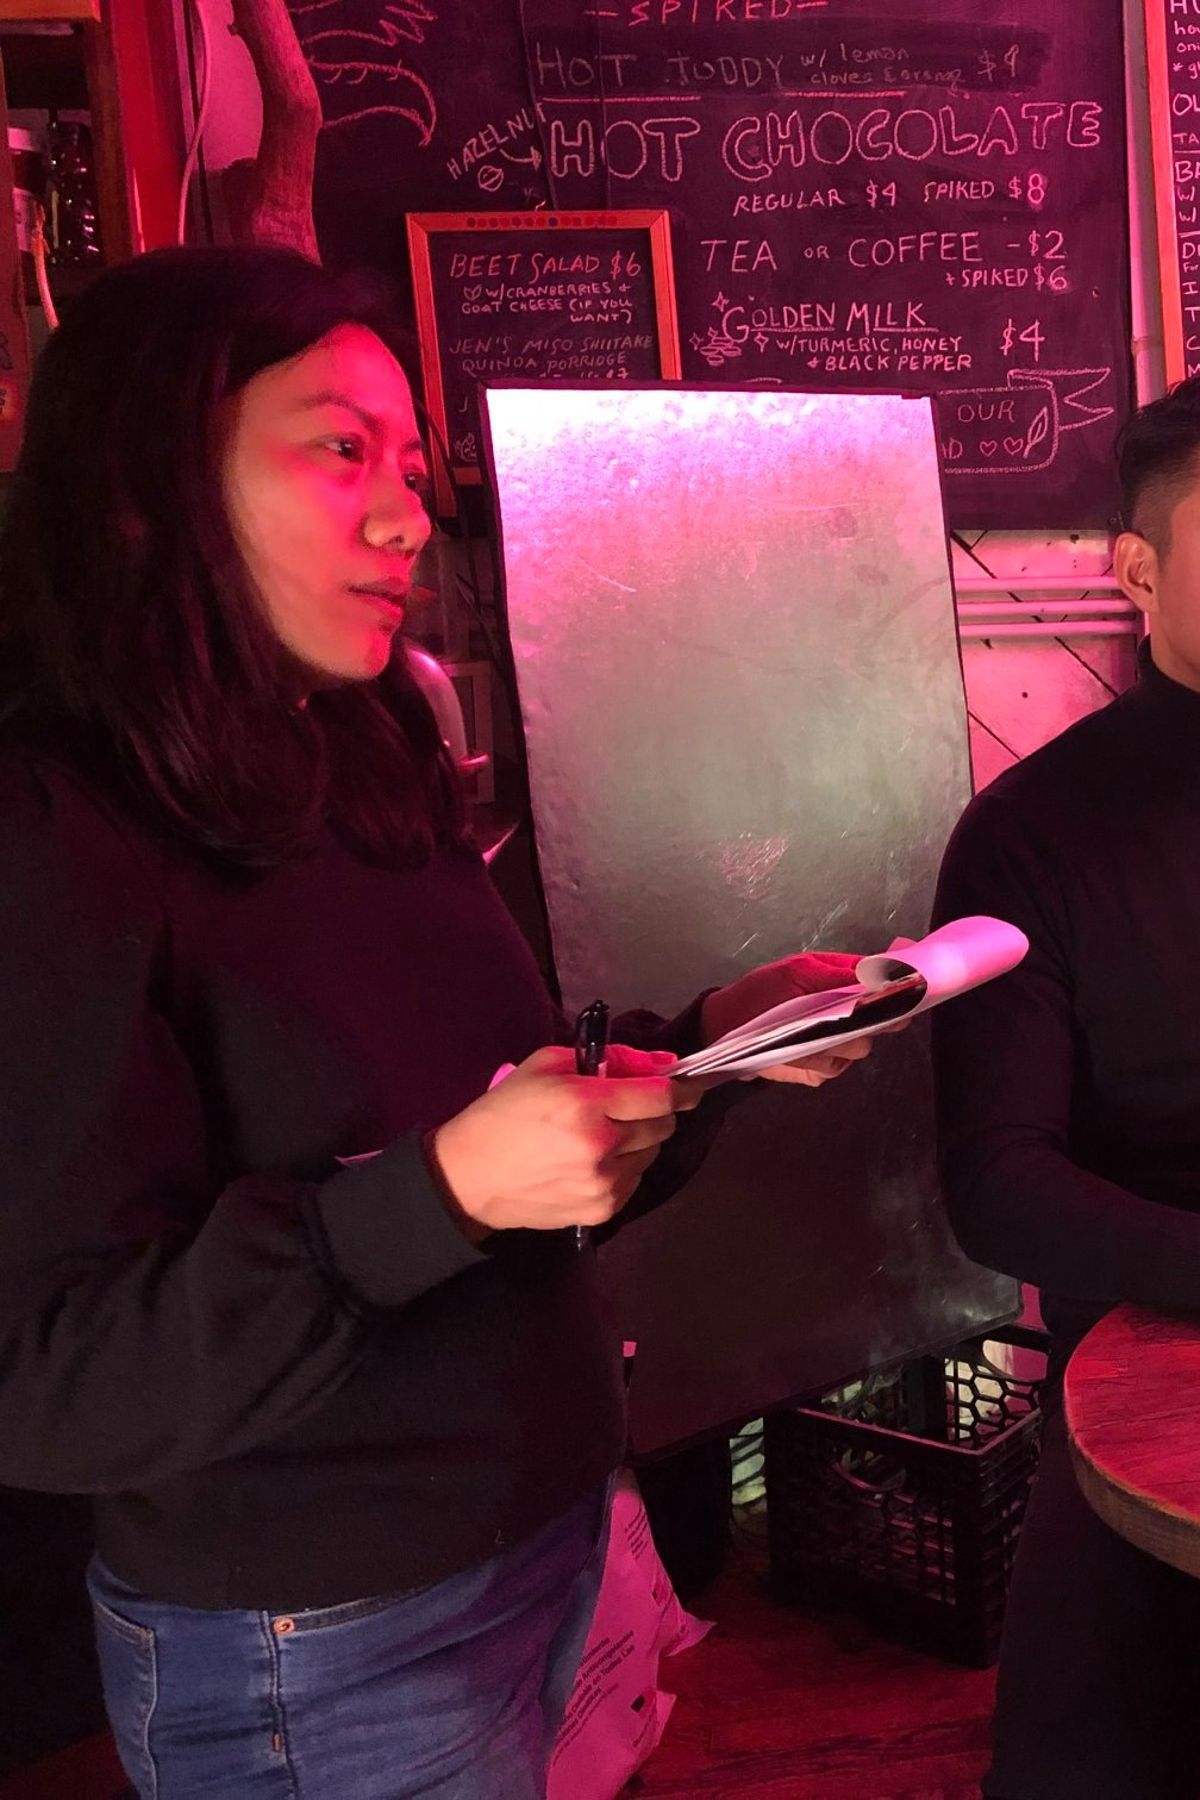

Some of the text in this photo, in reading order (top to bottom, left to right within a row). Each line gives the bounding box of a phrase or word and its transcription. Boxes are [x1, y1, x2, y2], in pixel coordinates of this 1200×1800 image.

[628, 0, 792, 27] SPIKED
[535, 41, 638, 89] HOT
[446, 102, 547, 181] HAZELNUT
[550, 100, 1103, 183] HOT CHOCOLATE
[732, 172, 1047, 216] REGULAR $4 SPIKED $8
[700, 239, 779, 273] TEA
[803, 245, 830, 260] OR
[847, 231, 983, 268] COFFEE
[450, 250, 642, 285] BEET SALAD $6
[961, 268, 1028, 288] SPIKED
[1033, 263, 1070, 292] $6
[462, 301, 500, 314] GOAT
[509, 300, 563, 313] CHEESE
[600, 299, 633, 309] YOU
[521, 336, 574, 353] MISO
[722, 302, 1046, 362] GOLDEN MILK $4
[901, 336, 963, 353] HONEY
[462, 352, 628, 378] QUINOA PORRIDGE
[824, 355, 890, 371] BLACK
[898, 353, 973, 371] PEPPER
[957, 399, 1015, 423] OUR
